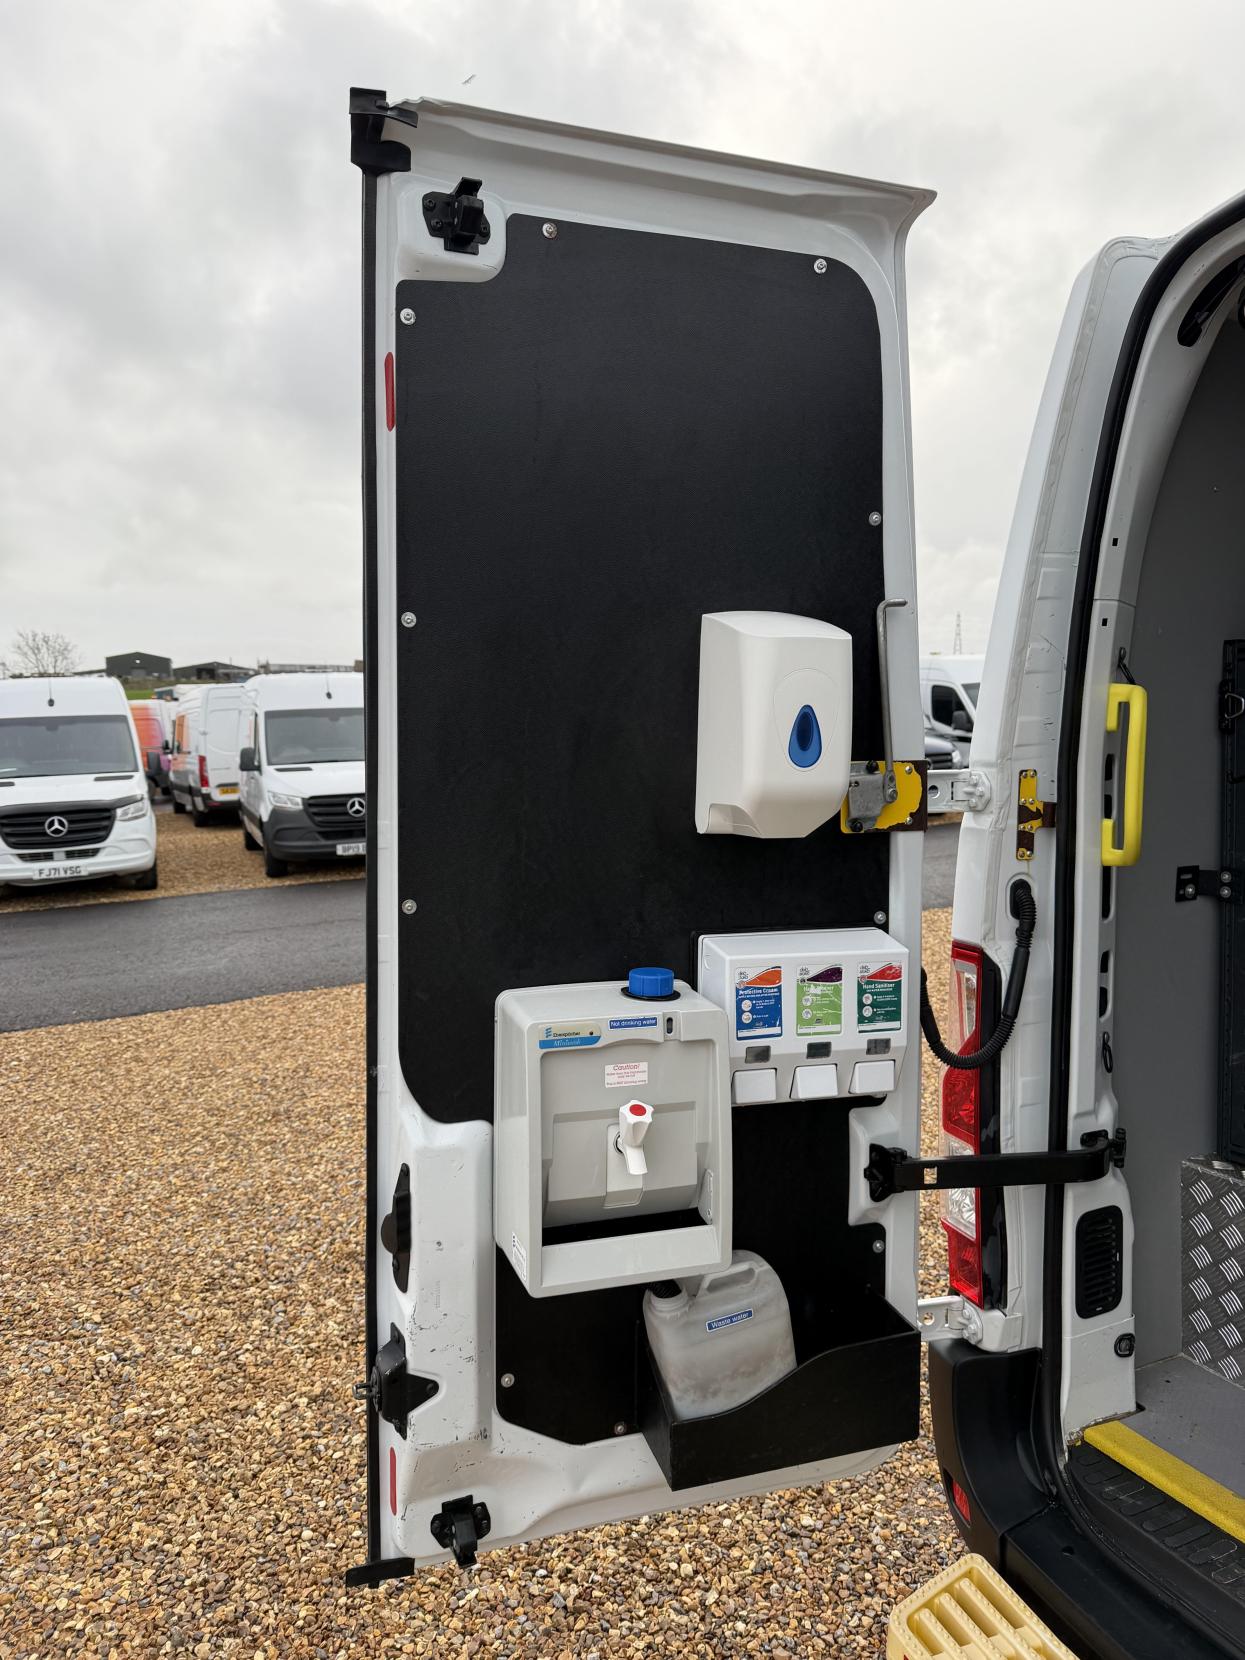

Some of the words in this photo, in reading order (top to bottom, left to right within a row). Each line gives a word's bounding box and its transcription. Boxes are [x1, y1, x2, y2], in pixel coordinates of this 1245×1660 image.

[38, 867, 60, 877] FJ71
[711, 1318, 730, 1328] Waste
[732, 1313, 749, 1321] water
